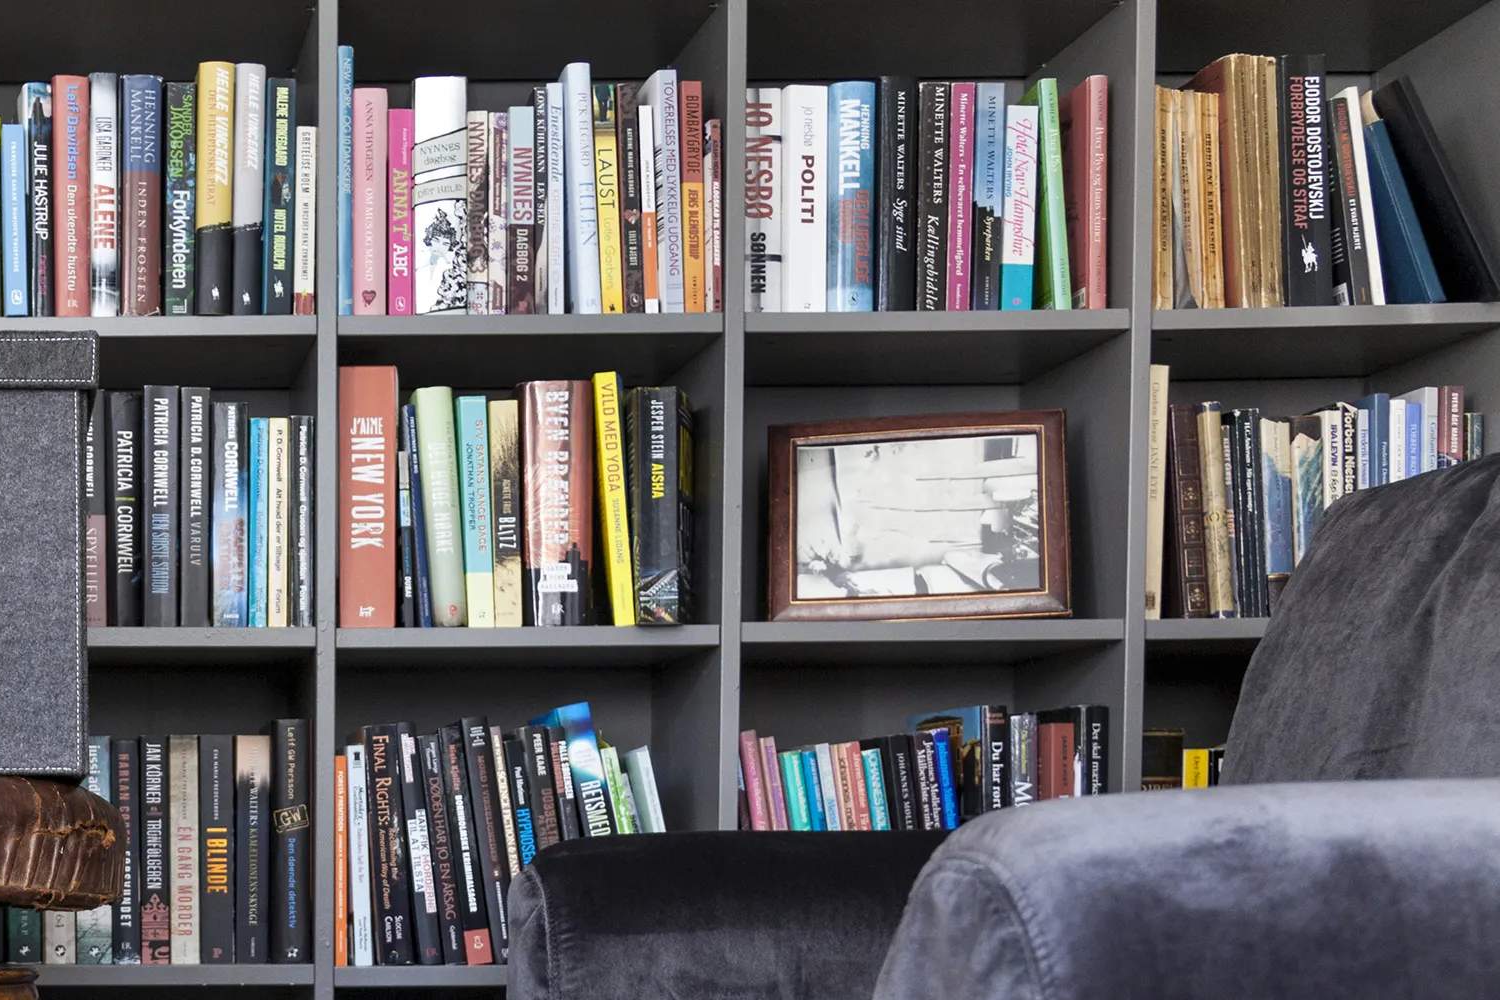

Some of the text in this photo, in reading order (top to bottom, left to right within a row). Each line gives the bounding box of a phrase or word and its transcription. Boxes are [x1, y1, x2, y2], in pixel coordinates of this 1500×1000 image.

[130, 90, 141, 162] MANKELL
[144, 90, 155, 163] HENNING
[182, 95, 191, 135] SANDER
[208, 90, 216, 110] DEN
[215, 68, 228, 185] HELLE VINCENTZ
[861, 104, 870, 149] HENNING
[897, 91, 905, 140] MINETTE
[959, 93, 968, 157] Minette Walters
[34, 141, 47, 175] JULIE
[95, 117, 112, 172] LISA GARDNER
[170, 106, 183, 178] JAKOBSEN
[365, 100, 373, 181] ANNA THYGESEN
[745, 102, 774, 221] JO NESBØ
[839, 99, 860, 195] MANKELL
[933, 86, 944, 204] MINETTE WALTERS
[986, 96, 996, 200] MINETTE WALTERS
[1289, 76, 1307, 230] FORBRYDELSE OG STRAF
[1305, 76, 1323, 219] FJODOR DOSTOJEVSKIJ
[207, 178, 215, 205] PIRAT
[513, 148, 532, 221] NYNNES
[598, 149, 615, 208] LAUST
[664, 81, 680, 276] TOVÆRELSES MED LYKKELIG UDGANG
[801, 155, 814, 224] POLITI
[35, 180, 48, 240] HASTRUP
[67, 185, 77, 291] Den ukendte hustru
[94, 185, 114, 249] ALENE
[169, 190, 190, 288] Forkynderen
[893, 198, 907, 251] Syge sind
[137, 182, 147, 303] INDEN FROSTEN
[393, 243, 407, 276] ABC
[516, 229, 529, 270] DAGBOG
[750, 232, 766, 293] SØNNEN
[923, 214, 940, 310] Kællingebidslet
[227, 406, 235, 439] PATRICIA
[350, 417, 383, 435] J'AIME
[545, 390, 569, 441] BYEN
[650, 400, 664, 459] JESPER STEIN
[153, 398, 169, 507] PATRICIA CORNWELL
[225, 442, 238, 512] CORNWELL
[651, 464, 664, 499] AISHA
[350, 437, 385, 549] NEW YORK
[190, 522, 200, 565] VARULV
[146, 743, 161, 761] JAN
[287, 727, 295, 799] Leif GW Persson
[533, 733, 546, 776] PEER KAAE
[1092, 723, 1100, 759] Det skal
[146, 764, 163, 803] KÖRNER
[372, 735, 392, 825] FINAL RIGHTS:
[896, 753, 908, 799] JOHANNES
[992, 742, 1003, 808] Du har rørt
[279, 808, 302, 826] GW
[496, 771, 515, 845] SCIENCE FICTION
[207, 839, 227, 893] BLINDE
[436, 845, 448, 860] JO
[440, 863, 450, 879] EN
